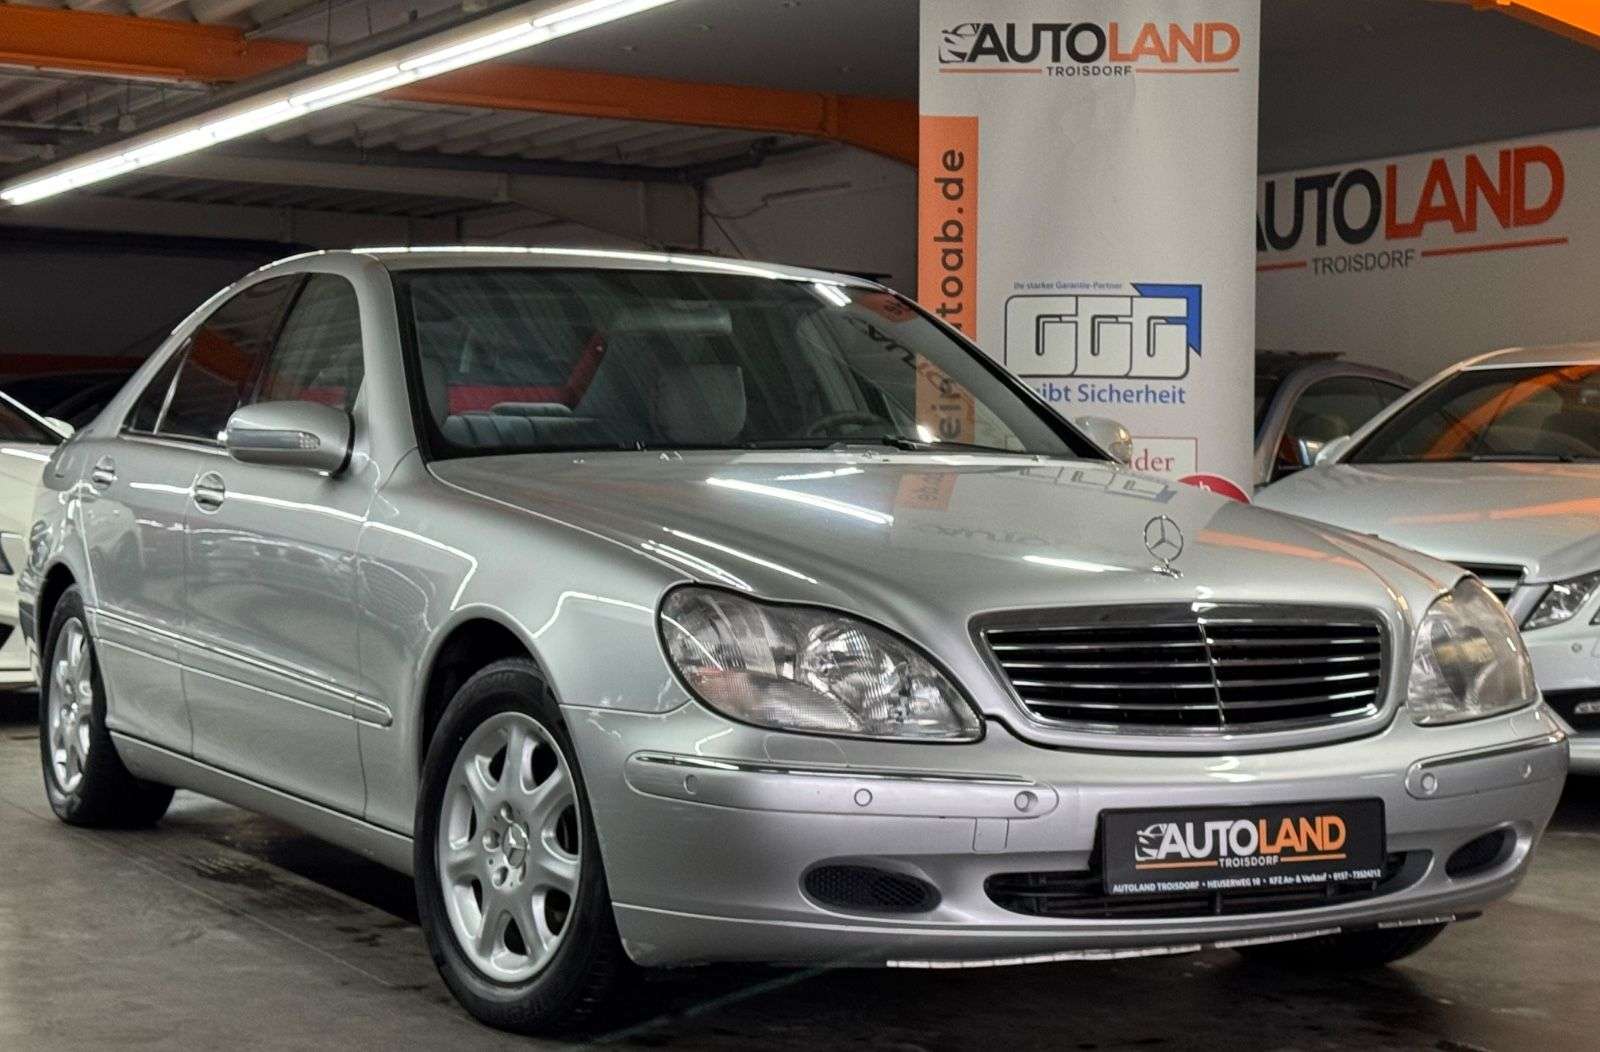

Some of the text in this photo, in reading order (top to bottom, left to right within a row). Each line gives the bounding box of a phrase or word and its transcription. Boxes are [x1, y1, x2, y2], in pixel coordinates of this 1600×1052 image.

[967, 22, 1241, 64] AUTOLAND
[1046, 66, 1132, 77] TROISDORF
[1312, 249, 1415, 276] TROISDORF
[1037, 383, 1186, 404] ibt Sicherheit
[1156, 815, 1346, 859] AUTOLAND
[1219, 855, 1280, 869] TROISDORF
[1112, 881, 1155, 893] AUTOLAND
[1157, 880, 1199, 891] TROISDORF
